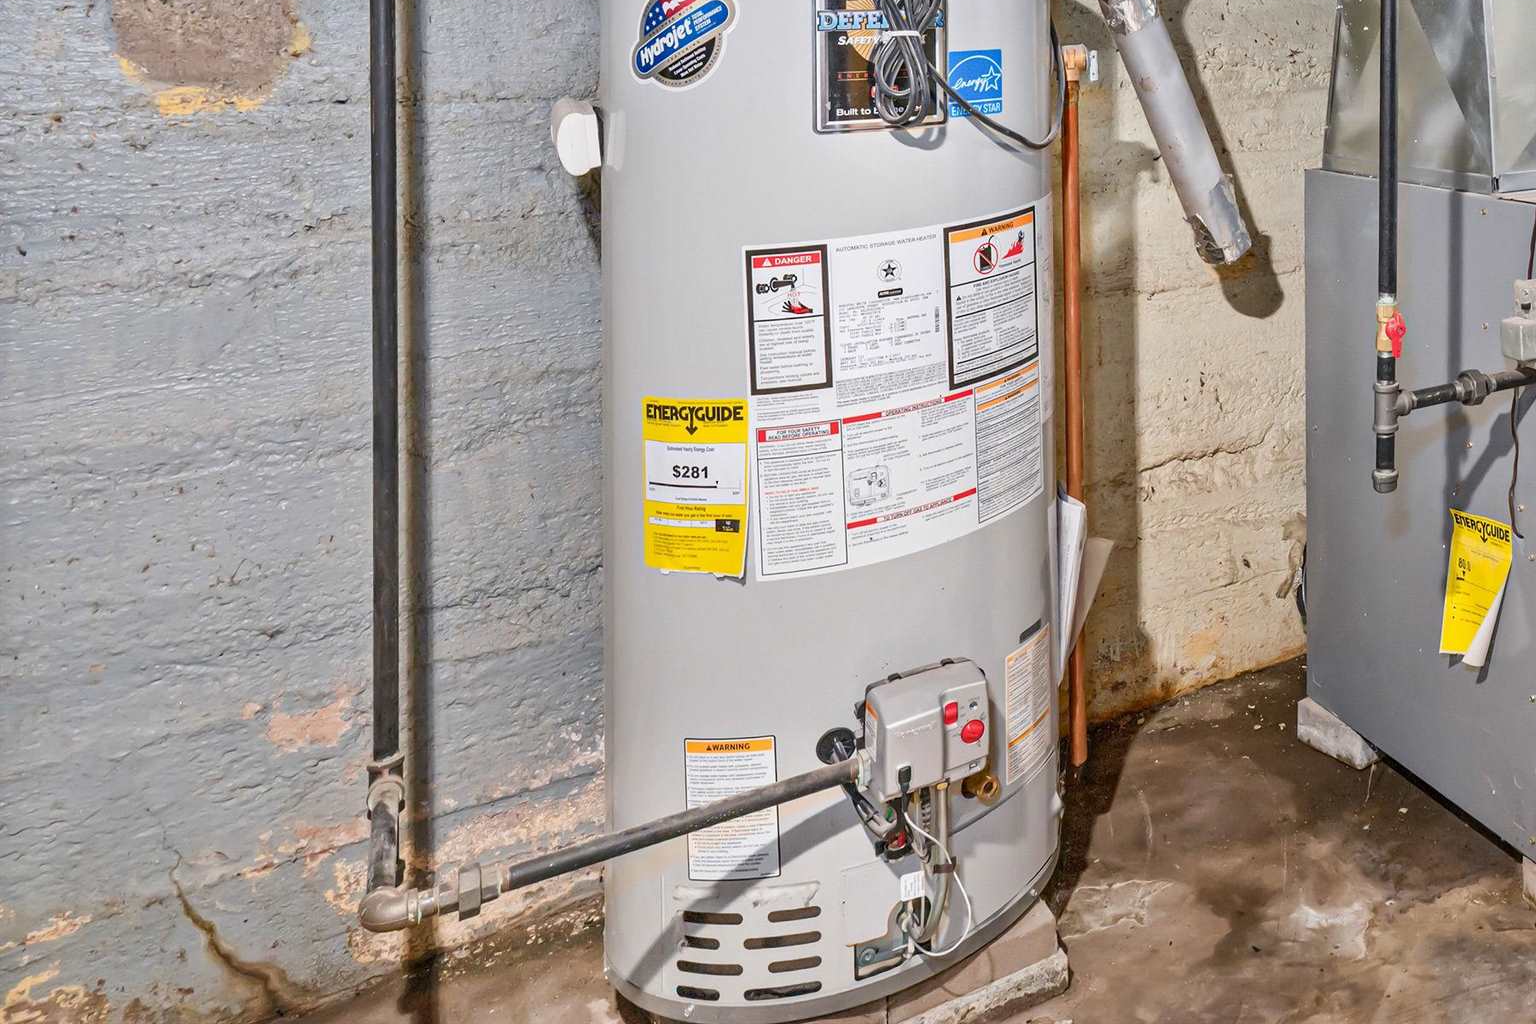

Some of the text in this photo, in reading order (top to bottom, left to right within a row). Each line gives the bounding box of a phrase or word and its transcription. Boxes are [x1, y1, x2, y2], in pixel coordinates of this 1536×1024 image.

[640, 16, 693, 67] Hydrojet
[836, 107, 859, 117] Built
[861, 107, 872, 116] to
[983, 102, 1001, 114] STAR
[989, 221, 1014, 233] WARNING
[836, 233, 937, 253] AUTOMATIC STORAGE WATER HEATER
[774, 255, 812, 265] DANGER
[646, 404, 744, 422] ENERGYGUIDE
[672, 465, 708, 479] $281
[1454, 513, 1511, 543] ENERGYGUIDE
[712, 743, 751, 751] WARNING
